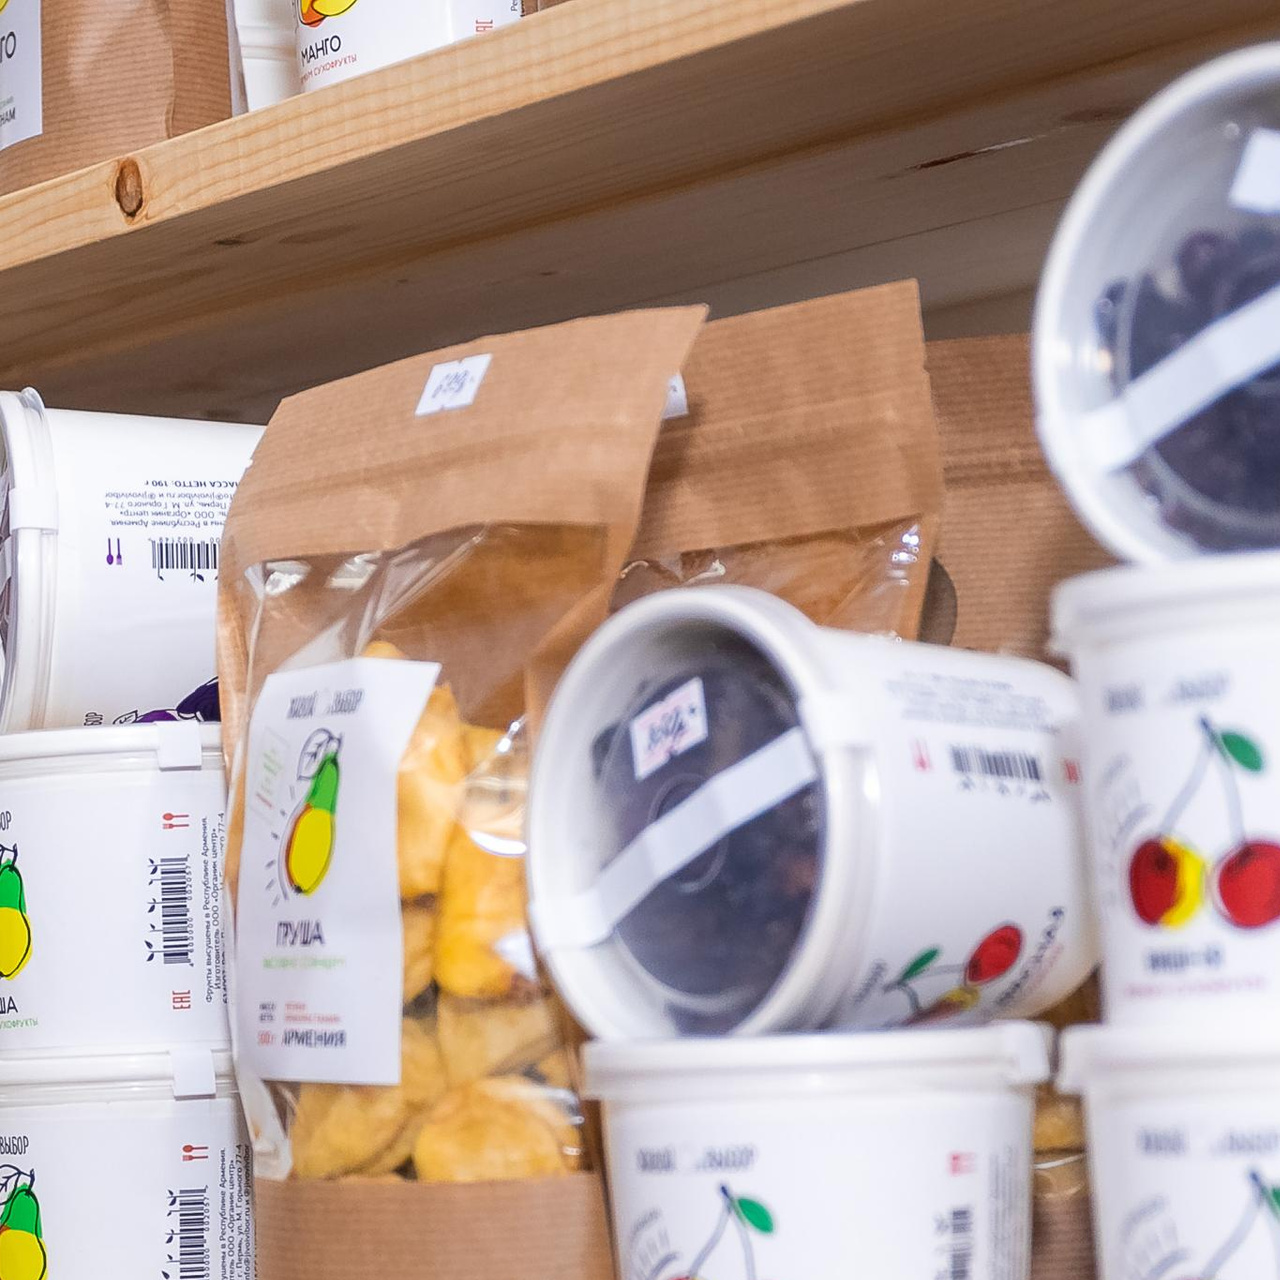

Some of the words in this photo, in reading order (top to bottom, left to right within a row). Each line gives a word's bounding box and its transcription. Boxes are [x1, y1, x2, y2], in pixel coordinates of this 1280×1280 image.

[300, 34, 342, 68] МАНГО
[314, 53, 357, 77] СУХОФРУКТЫ
[151, 520, 201, 528] Республике
[202, 859, 211, 910] Республике
[211, 905, 220, 927] ООО
[276, 920, 326, 946] ГРУША
[206, 968, 214, 1003] Фрукты
[282, 1029, 347, 1048] АРМЕНИЯ
[235, 1167, 244, 1208] Горького
[219, 1190, 228, 1241] Республике
[227, 1235, 235, 1257] ООО
[235, 1237, 244, 1268] Пермь,
